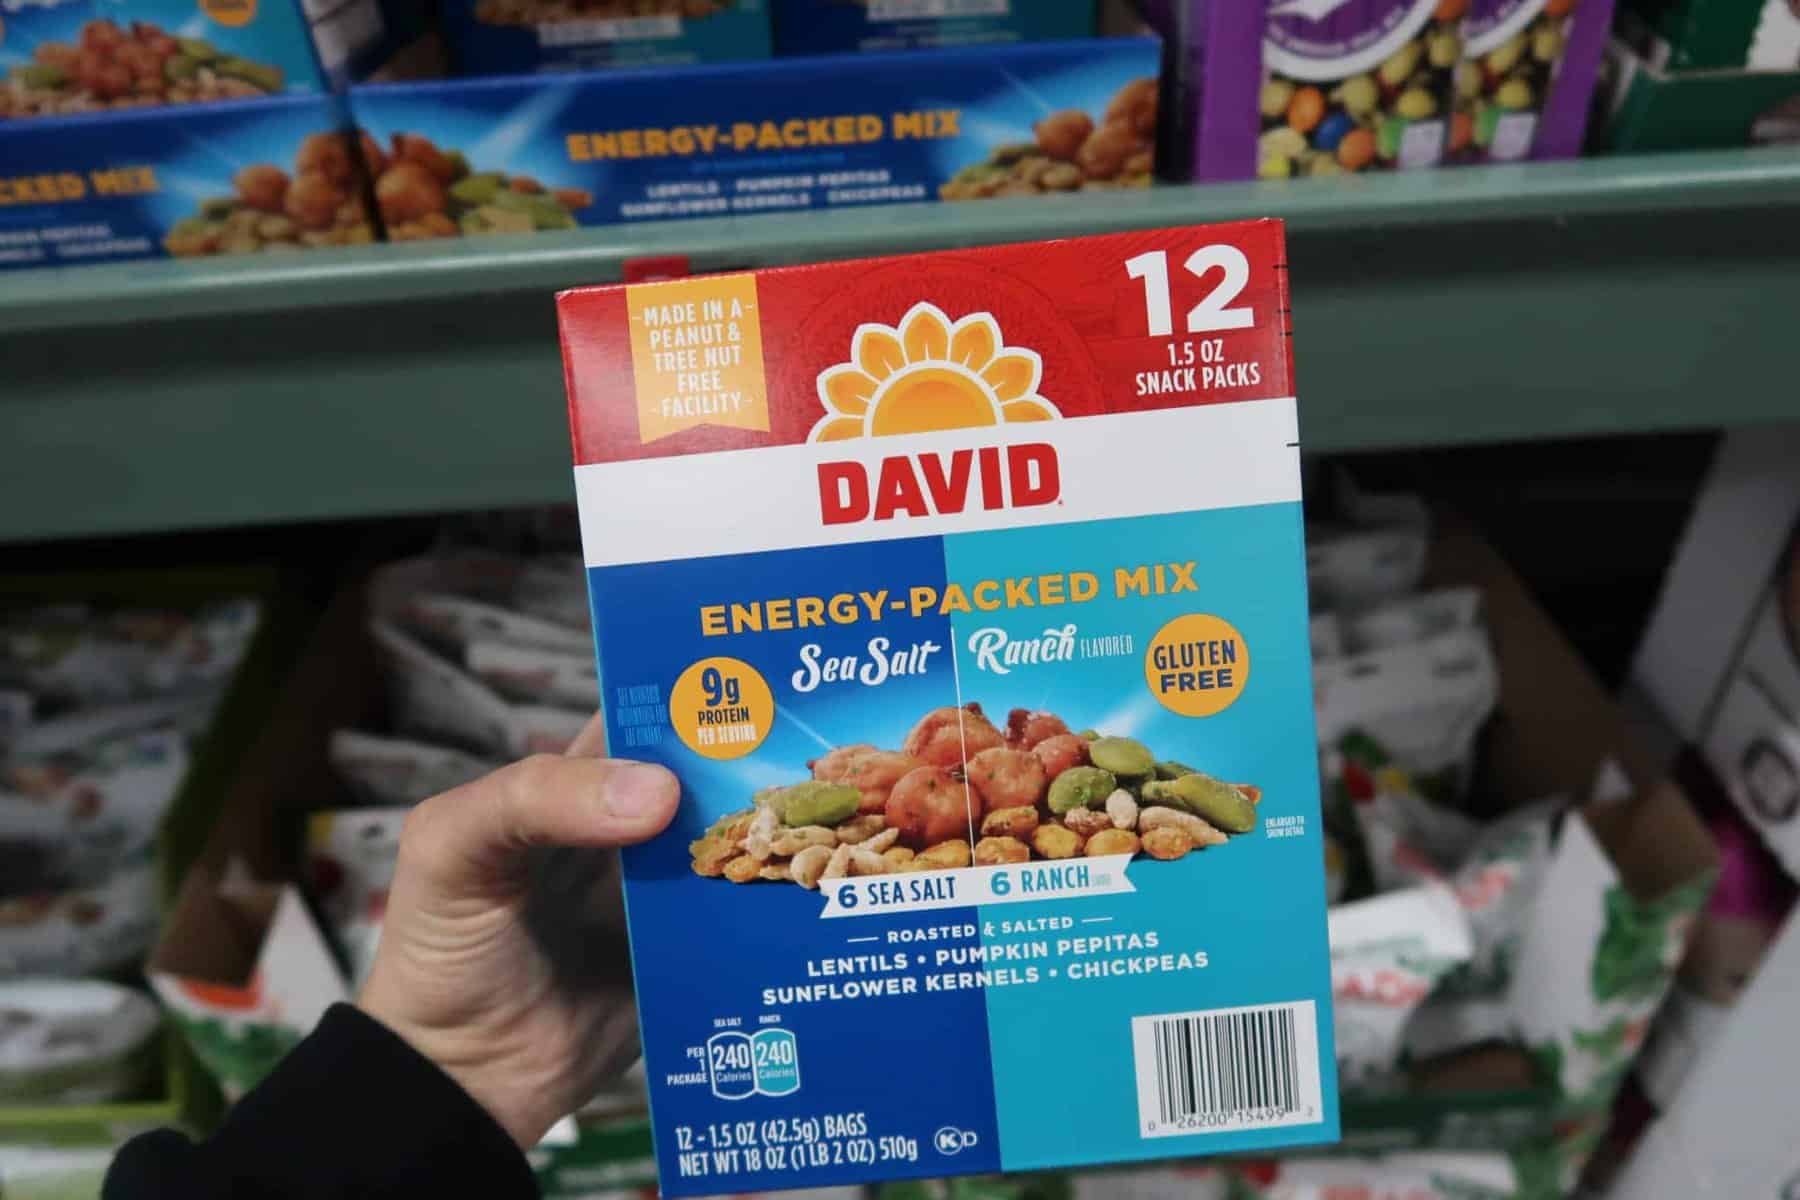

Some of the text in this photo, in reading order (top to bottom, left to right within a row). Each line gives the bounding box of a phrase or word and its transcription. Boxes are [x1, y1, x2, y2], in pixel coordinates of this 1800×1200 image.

[566, 110, 961, 161] ENERGY-PACKED MIX
[1125, 244, 1254, 337] 12
[643, 297, 742, 326] MADE IN A
[650, 322, 741, 350] PEANUT &
[654, 346, 741, 372] TREE NUT
[1168, 338, 1224, 367] 1.5 OZ
[677, 371, 722, 394] FREE
[1136, 362, 1261, 396] SNACK PACKS
[662, 392, 741, 417] FACILITY
[817, 443, 1060, 526] DAVID
[701, 561, 1199, 637] ENERGY-PACKED MIX
[791, 637, 942, 692] Sea Salt
[968, 623, 1134, 675] Ranch FLAVORED
[1153, 639, 1237, 671] GLUTEN
[702, 667, 740, 707] 9g
[1160, 668, 1234, 694] FREE
[698, 707, 749, 726] PROTEIN
[837, 876, 955, 908] 6 SEA SALT
[991, 871, 1011, 896] 6
[1021, 865, 1089, 893] RANCH
[887, 916, 1074, 944] ROASTED & SALTED
[807, 932, 1160, 978] LENTILS PUMPKIN PEPITAS
[763, 952, 1210, 1006] SUNFLOWER KERNELS CHICKPEAS
[686, 1047, 706, 1059] PER
[713, 1039, 793, 1070] 240 240
[667, 1071, 708, 1086] PACKAGE
[716, 1071, 752, 1083] Calories
[759, 1068, 796, 1080] Calories
[675, 1125, 694, 1150] 12
[709, 1123, 733, 1148] 1.5
[735, 1120, 758, 1145] OZ
[761, 1116, 820, 1147] (42.5g)
[823, 1112, 868, 1139] BAGS
[1177, 1112, 1228, 1129] 26200
[1237, 1107, 1286, 1125] 15499
[679, 1135, 918, 1177] NET WT 18 OZ (1 LB 2 OZ) 510g
